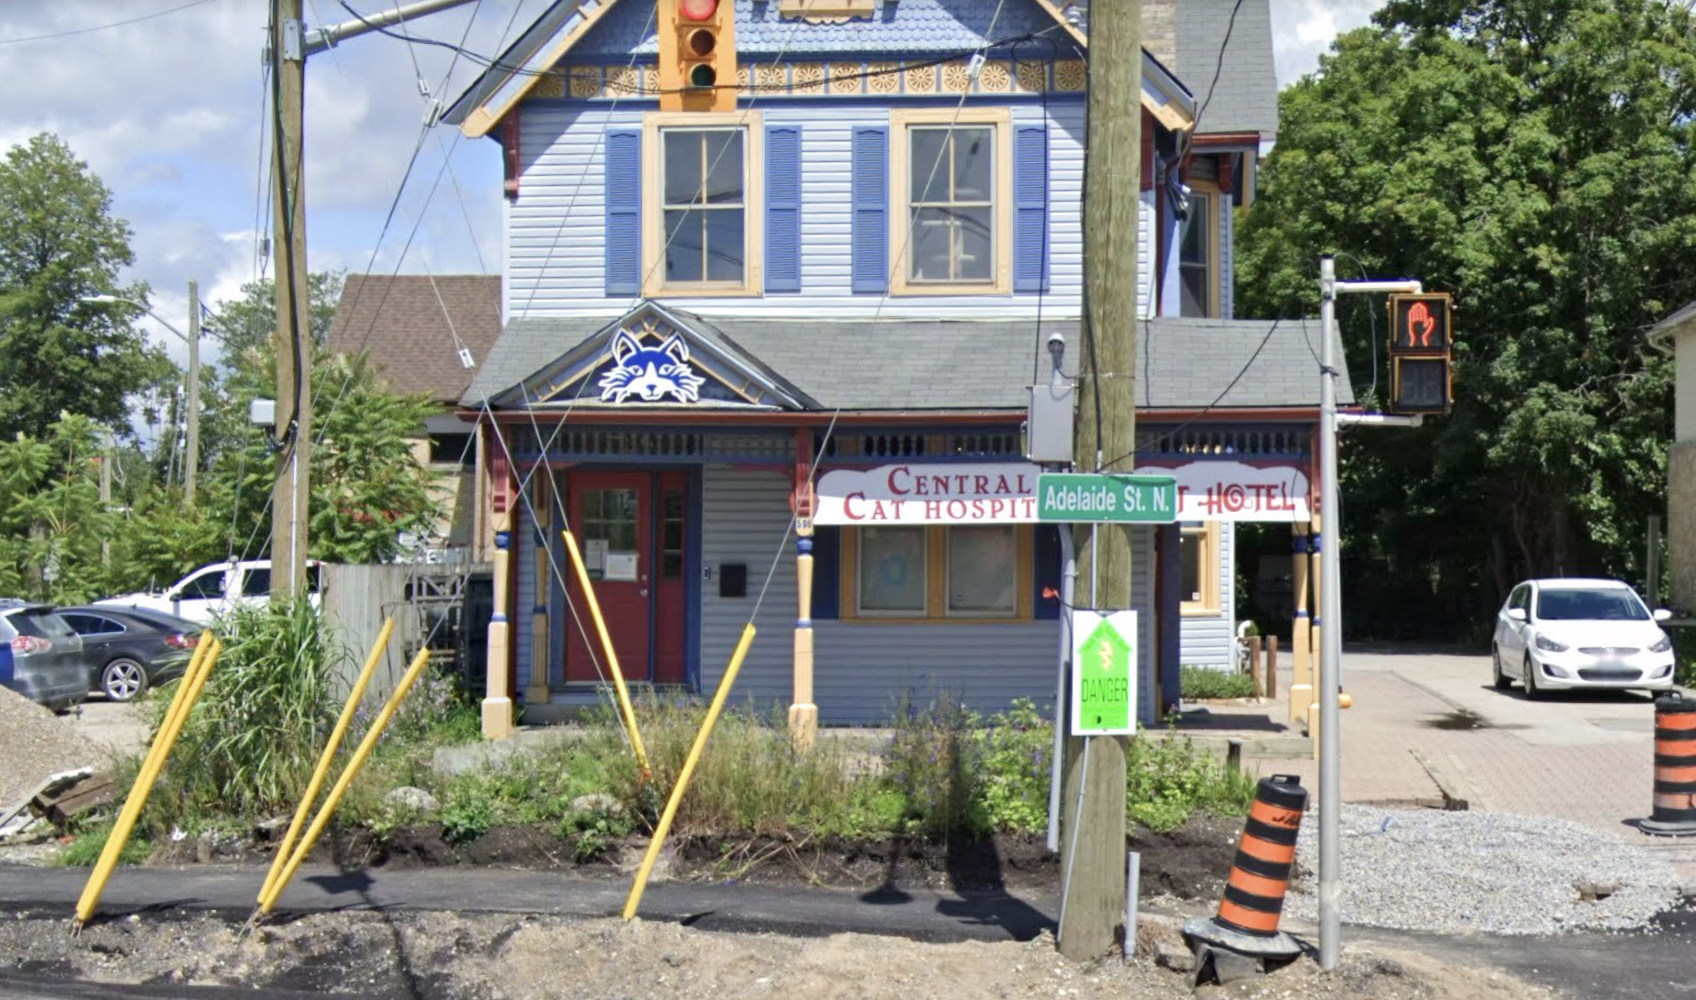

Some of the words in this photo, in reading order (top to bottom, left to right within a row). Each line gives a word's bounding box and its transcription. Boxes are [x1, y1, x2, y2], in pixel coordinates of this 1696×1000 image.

[887, 466, 1031, 495] CENTRAL
[843, 491, 905, 520] CAT
[925, 498, 1036, 520] HOSPIT
[1044, 485, 1117, 511] Adelaide
[1123, 485, 1146, 512] St.
[1153, 486, 1170, 512] N.
[1197, 481, 1296, 515] HOTEL
[1081, 678, 1129, 702] DANGER
